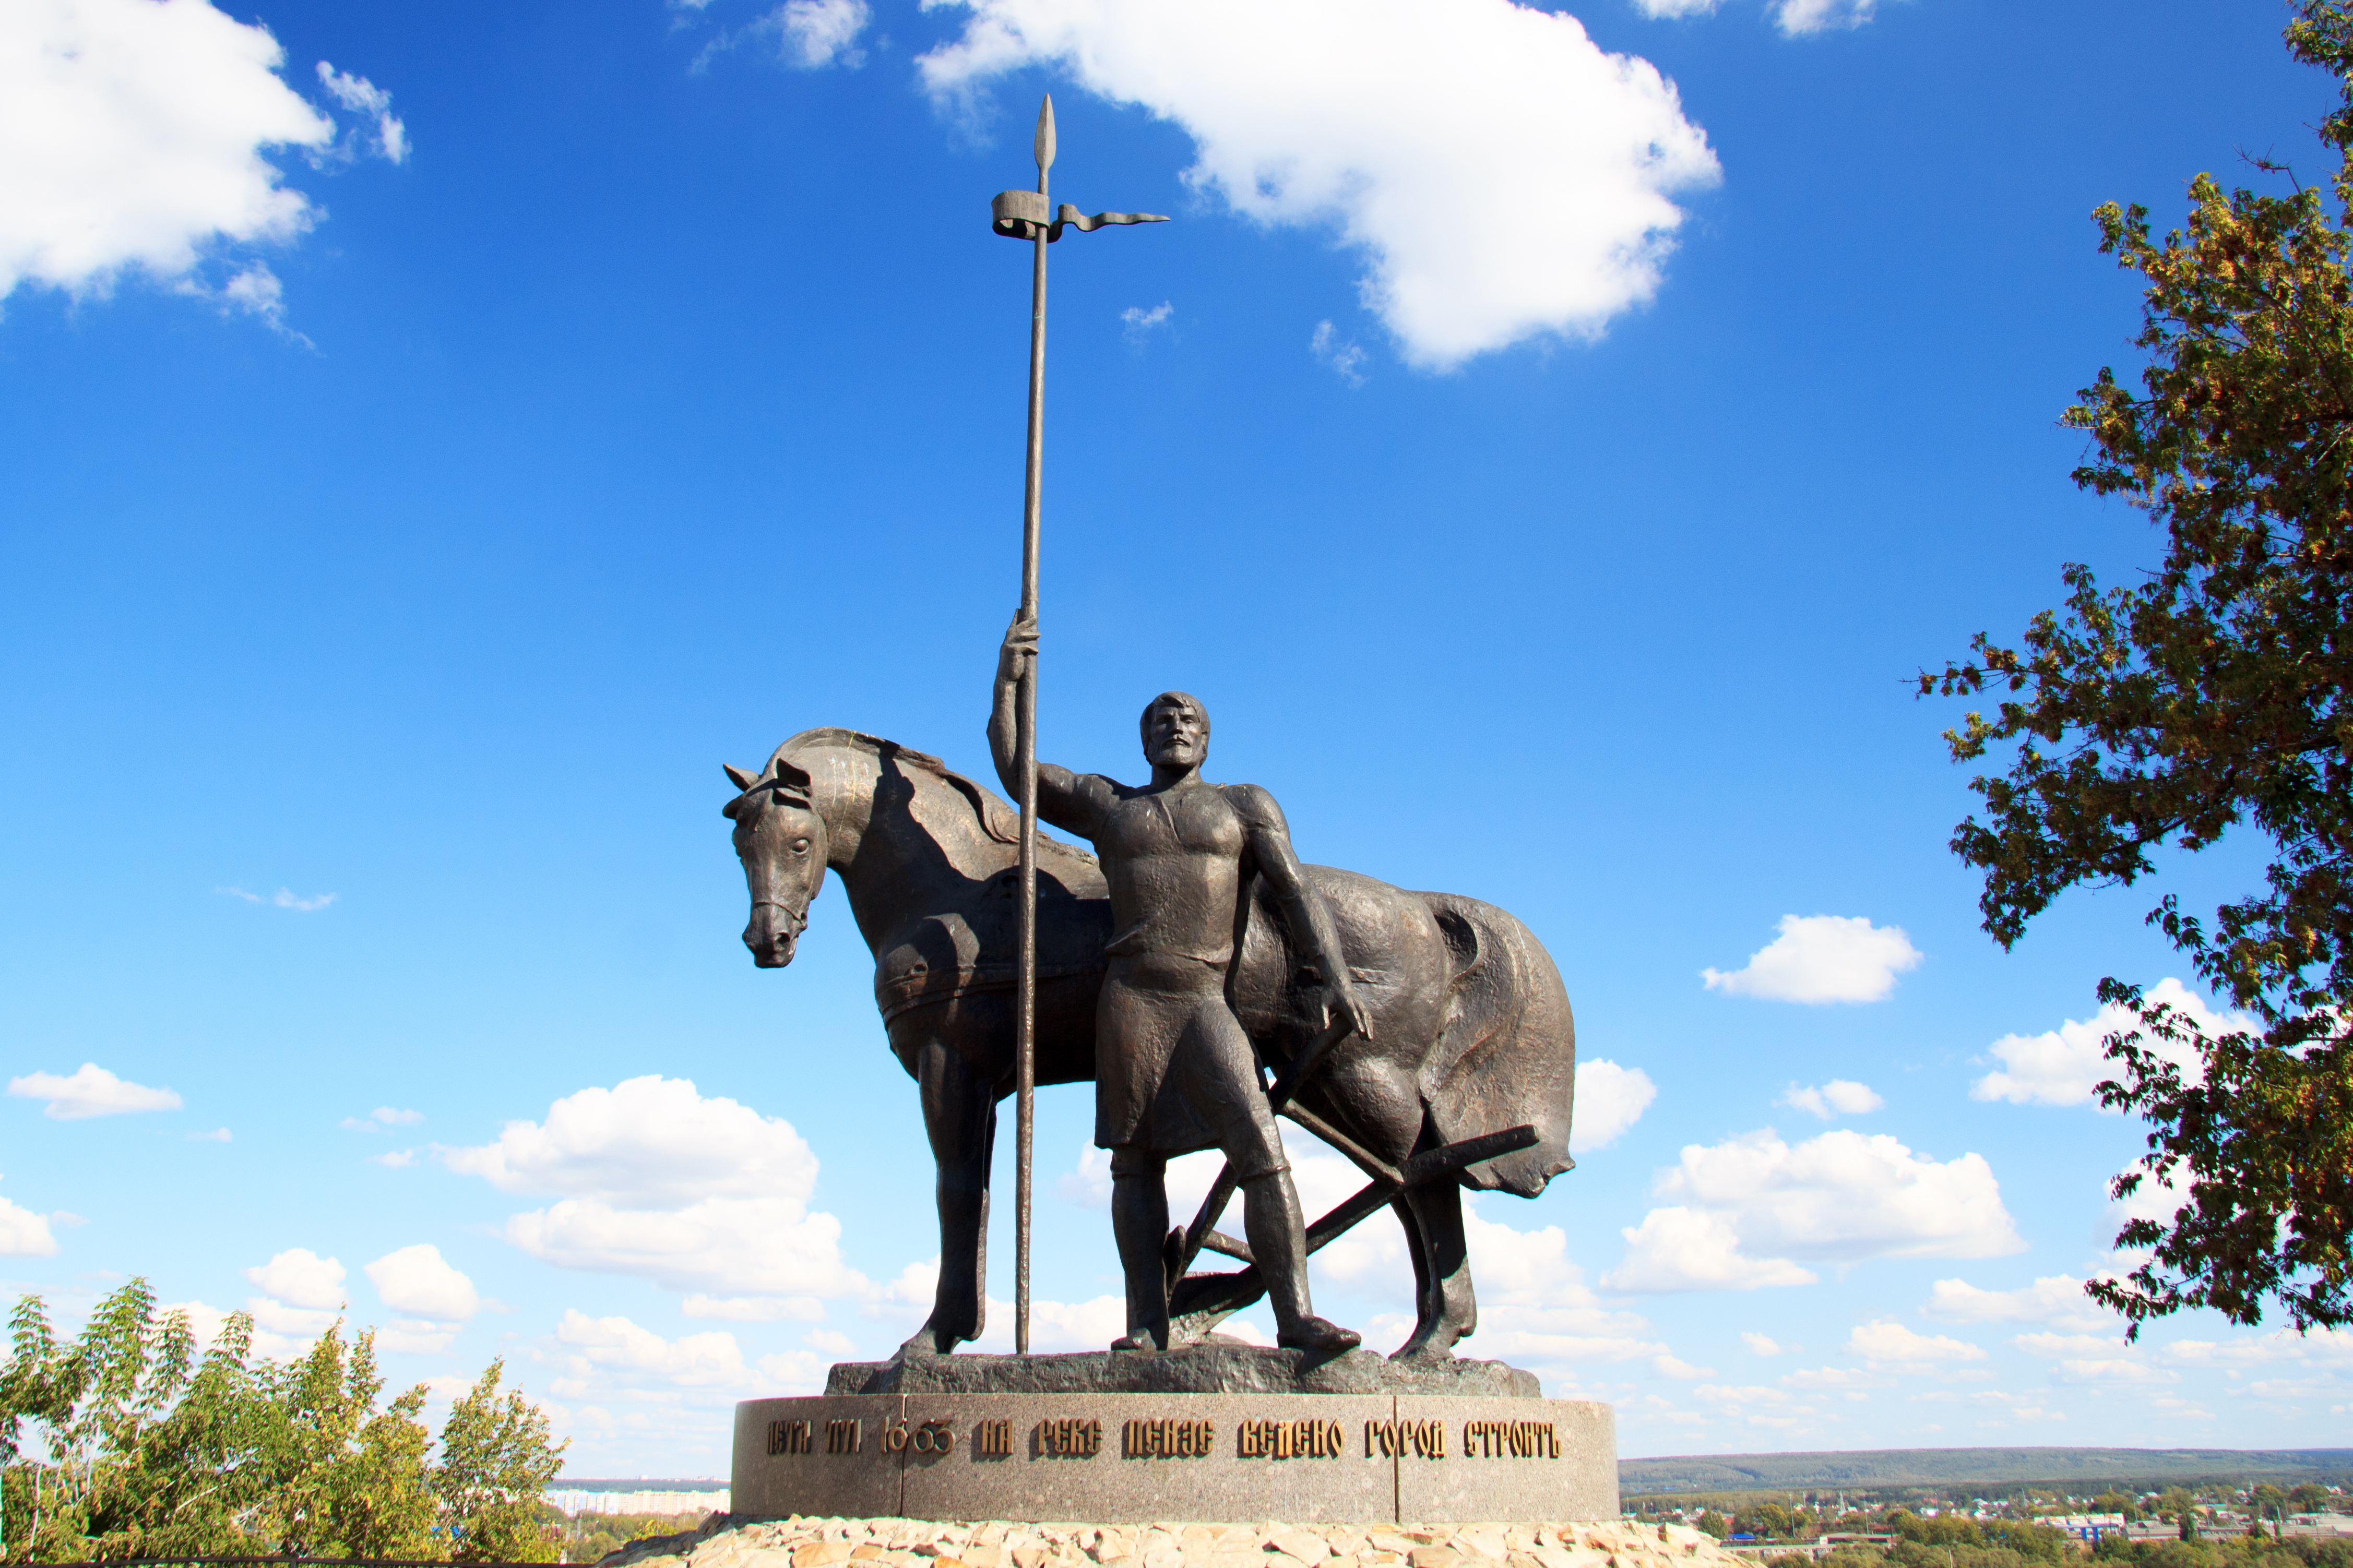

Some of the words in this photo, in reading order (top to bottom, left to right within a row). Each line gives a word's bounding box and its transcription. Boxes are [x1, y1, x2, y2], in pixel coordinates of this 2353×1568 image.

[881, 1417, 956, 1454] 1663
[981, 1419, 1014, 1454] НА
[1038, 1418, 1102, 1454] РЕКЕ
[1128, 1419, 1213, 1455] ПЕНЗЕ
[1243, 1418, 1345, 1456] ВЕЛЕНО
[1369, 1418, 1447, 1457] ГОРОД
[1467, 1419, 1562, 1456] СТРОИТЬ
